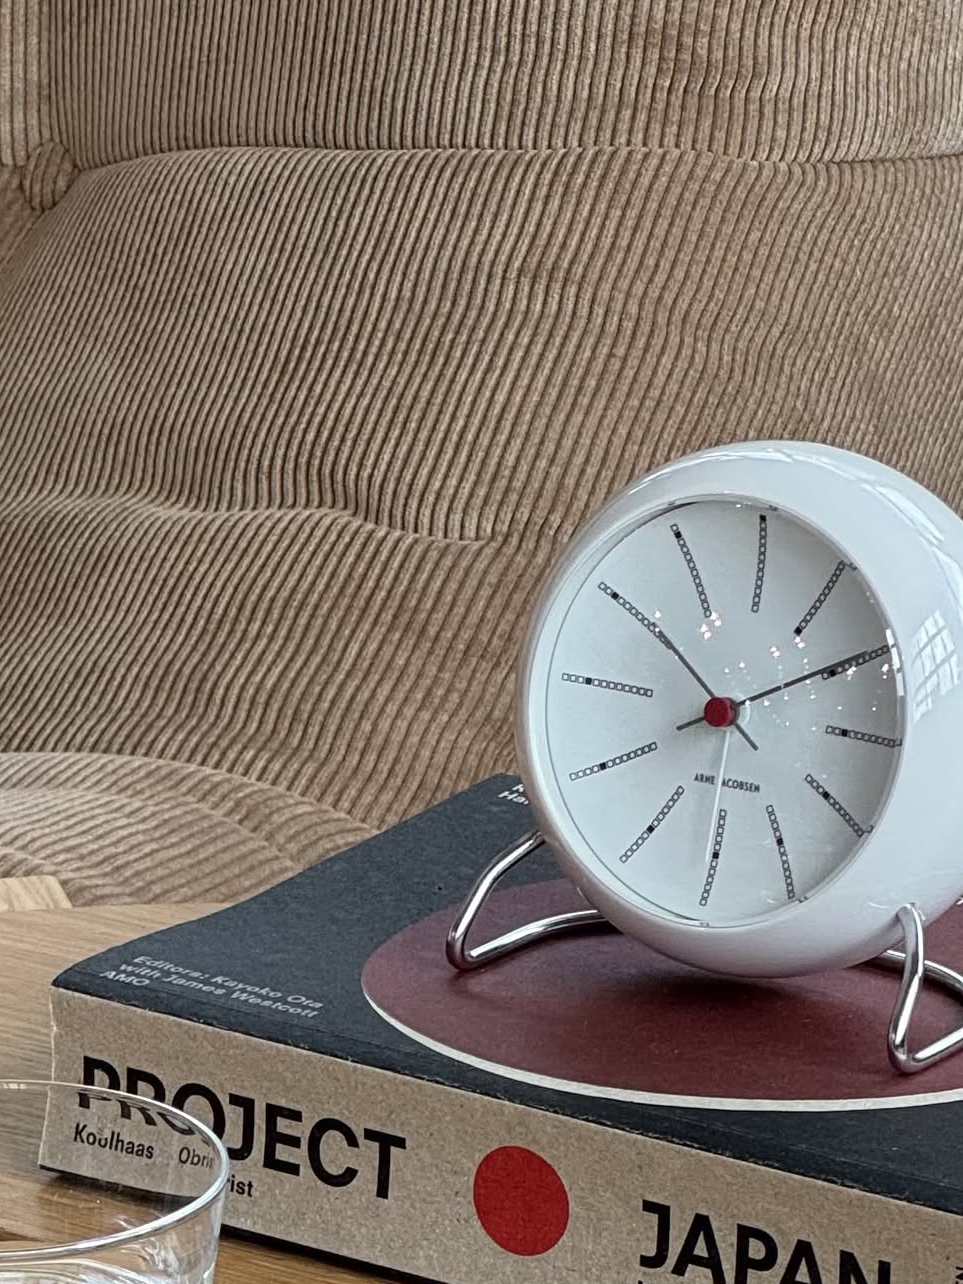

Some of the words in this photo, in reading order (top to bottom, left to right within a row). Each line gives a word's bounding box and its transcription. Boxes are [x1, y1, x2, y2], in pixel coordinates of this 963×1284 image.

[694, 772, 716, 785] ARNE
[721, 777, 760, 793] ACOBSEN
[100, 970, 151, 987] AMO
[120, 963, 161, 980] with
[164, 974, 227, 995] James
[231, 990, 320, 1019] Westcott
[133, 955, 209, 980] Editors:
[211, 975, 283, 999] Kayoko
[287, 994, 325, 1009] Ota
[78, 1055, 407, 1201] PROJECT
